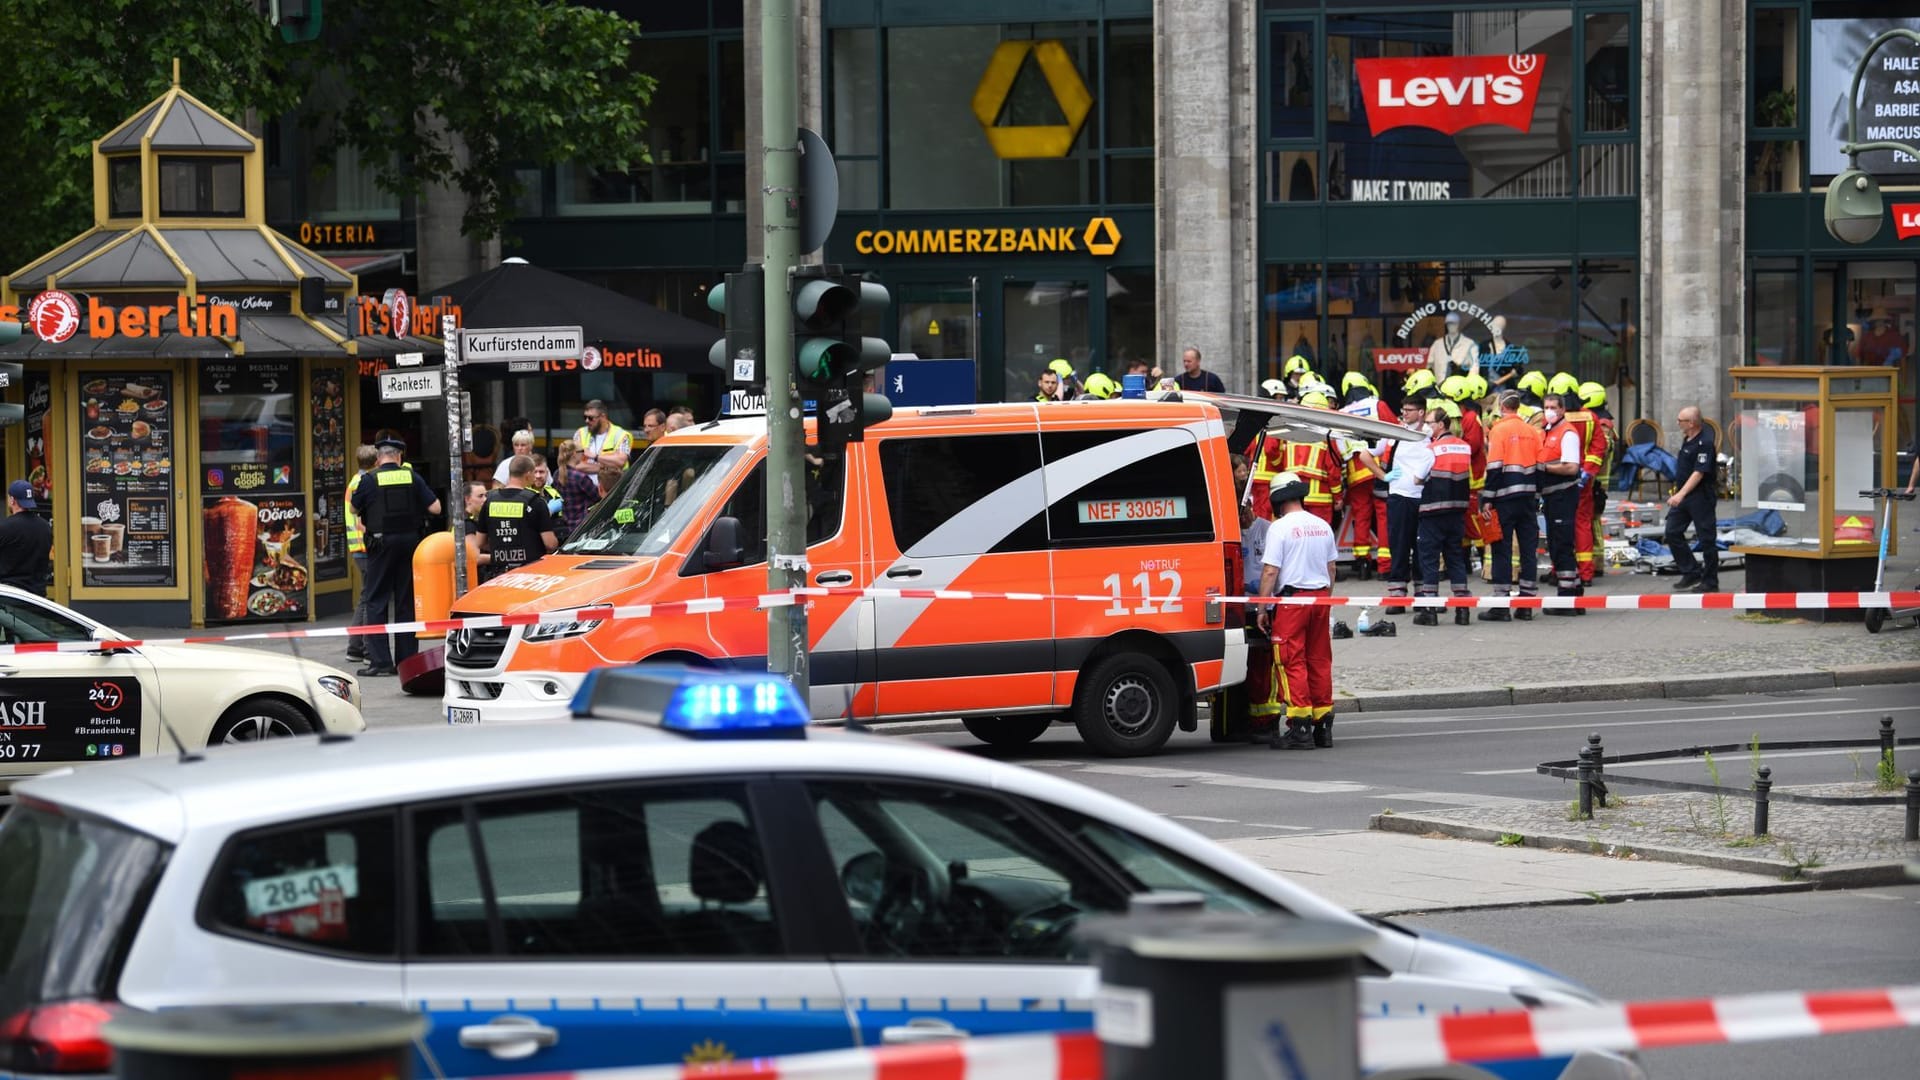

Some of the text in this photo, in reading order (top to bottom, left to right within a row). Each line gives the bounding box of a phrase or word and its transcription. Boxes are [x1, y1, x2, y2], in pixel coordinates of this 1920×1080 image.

[1352, 179, 1450, 201] MAKE IT YOURS
[300, 222, 375, 244] OSTERIA
[855, 227, 1076, 255] COMMERZBANK
[88, 294, 237, 339] berlin
[1396, 299, 1502, 340] RIDING TOGETHER
[468, 335, 576, 353] Kurfürstendamm
[602, 347, 661, 368] berlin
[391, 376, 433, 391] Rankestr.
[733, 393, 767, 410] NOTA
[258, 507, 303, 523] Döner
[491, 504, 521, 515] POLIZEI
[1088, 499, 1176, 520] NEF 3305/1
[500, 520, 511, 528] BE
[494, 549, 527, 562] POLIZEI
[1140, 559, 1181, 570] NOTRUF
[1103, 570, 1183, 616] 112
[75, 726, 136, 735] #Brandenburg
[21, 744, 41, 758] 77
